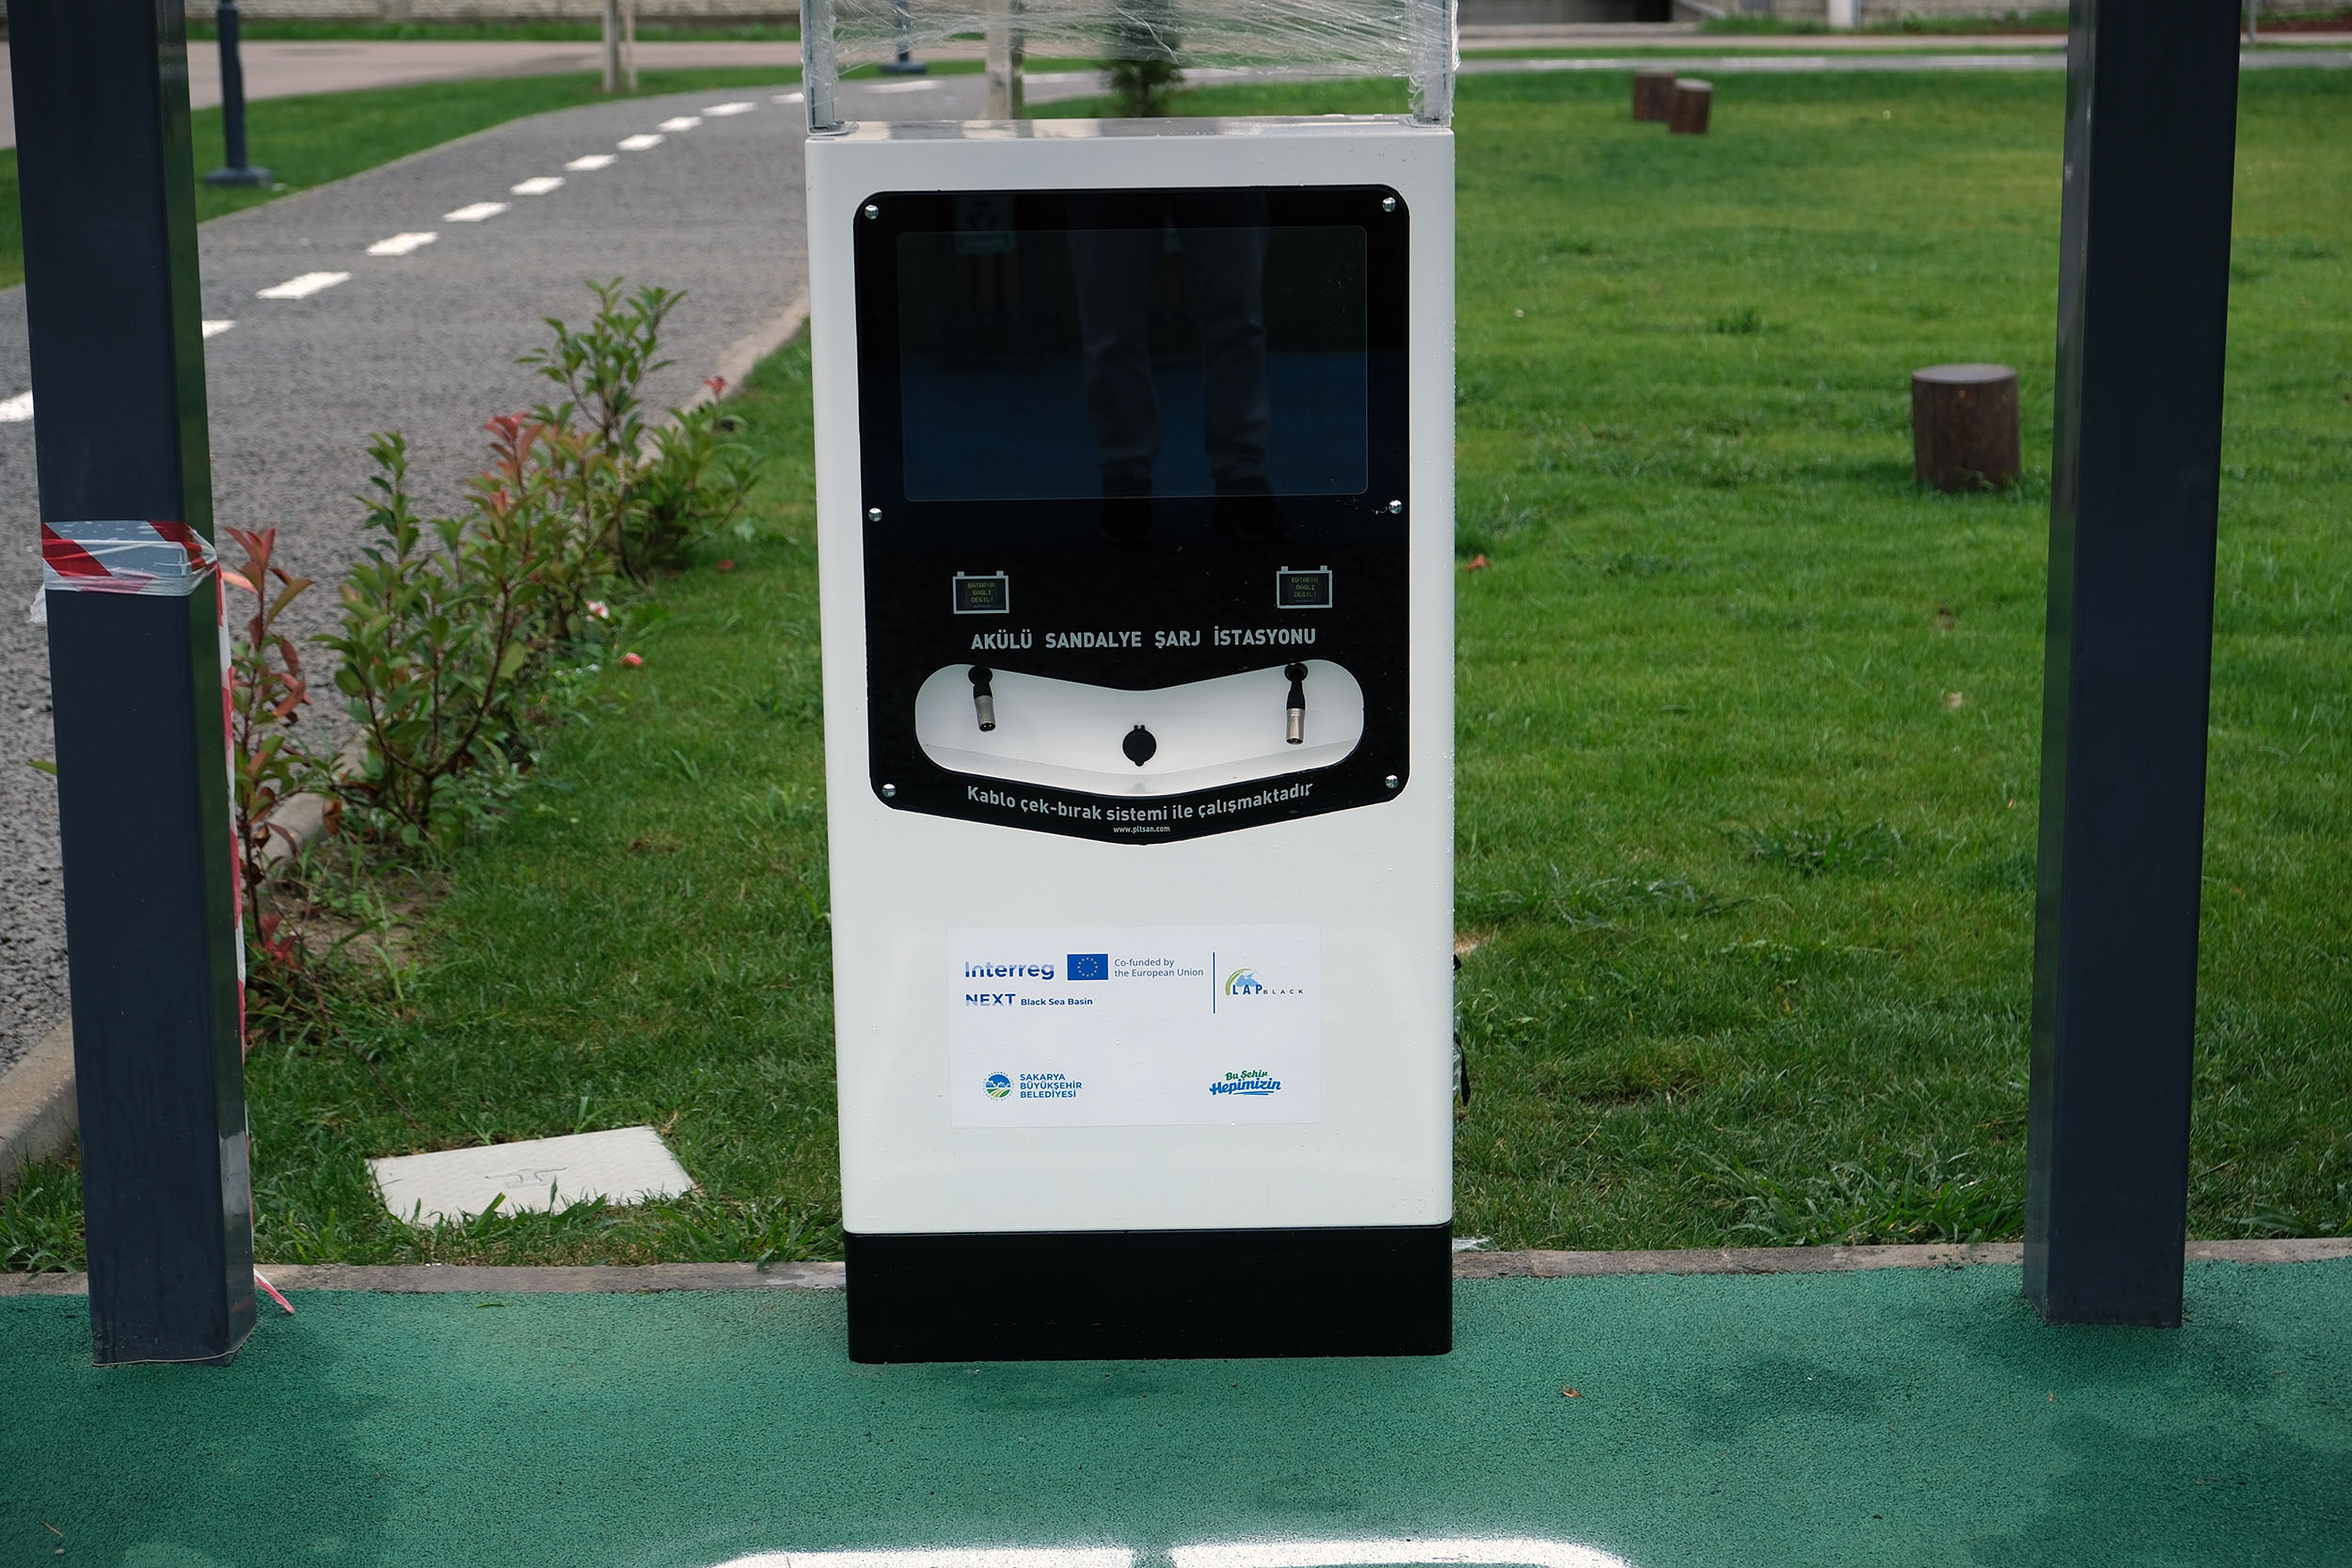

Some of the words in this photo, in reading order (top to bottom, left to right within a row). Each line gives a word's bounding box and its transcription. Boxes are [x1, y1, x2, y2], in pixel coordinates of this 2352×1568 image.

[971, 628, 1032, 649] AKÜLÜ
[1045, 631, 1142, 648] SANDALYE
[1154, 630, 1200, 649] ŞARJ
[1214, 626, 1316, 645] İSTASYONU
[967, 785, 1016, 808] Kablo
[1020, 799, 1102, 820] çek-bırak
[1106, 805, 1168, 821] sistemi
[1172, 805, 1193, 819] ile
[1198, 783, 1313, 818] çalışmaktadır
[1113, 825, 1170, 834] www.pltsan.com
[1114, 958, 1161, 967] Co-funded
[1164, 958, 1174, 968] by
[965, 961, 1055, 980] Interreg
[1114, 969, 1129, 977] the
[1132, 969, 1174, 978] European
[1177, 968, 1204, 976] Union
[1232, 984, 1263, 995] LAP
[965, 993, 1016, 1006] NEXT
[1068, 997, 1093, 1006] Basin
[1225, 1071, 1239, 1081] Bu
[1240, 1069, 1268, 1081] Şehir
[1020, 1081, 1082, 1090] BÜYÜKŞEHİR
[1209, 1077, 1281, 1095] Hepimizin
[1020, 1089, 1076, 1098] BELEDİYESİ
